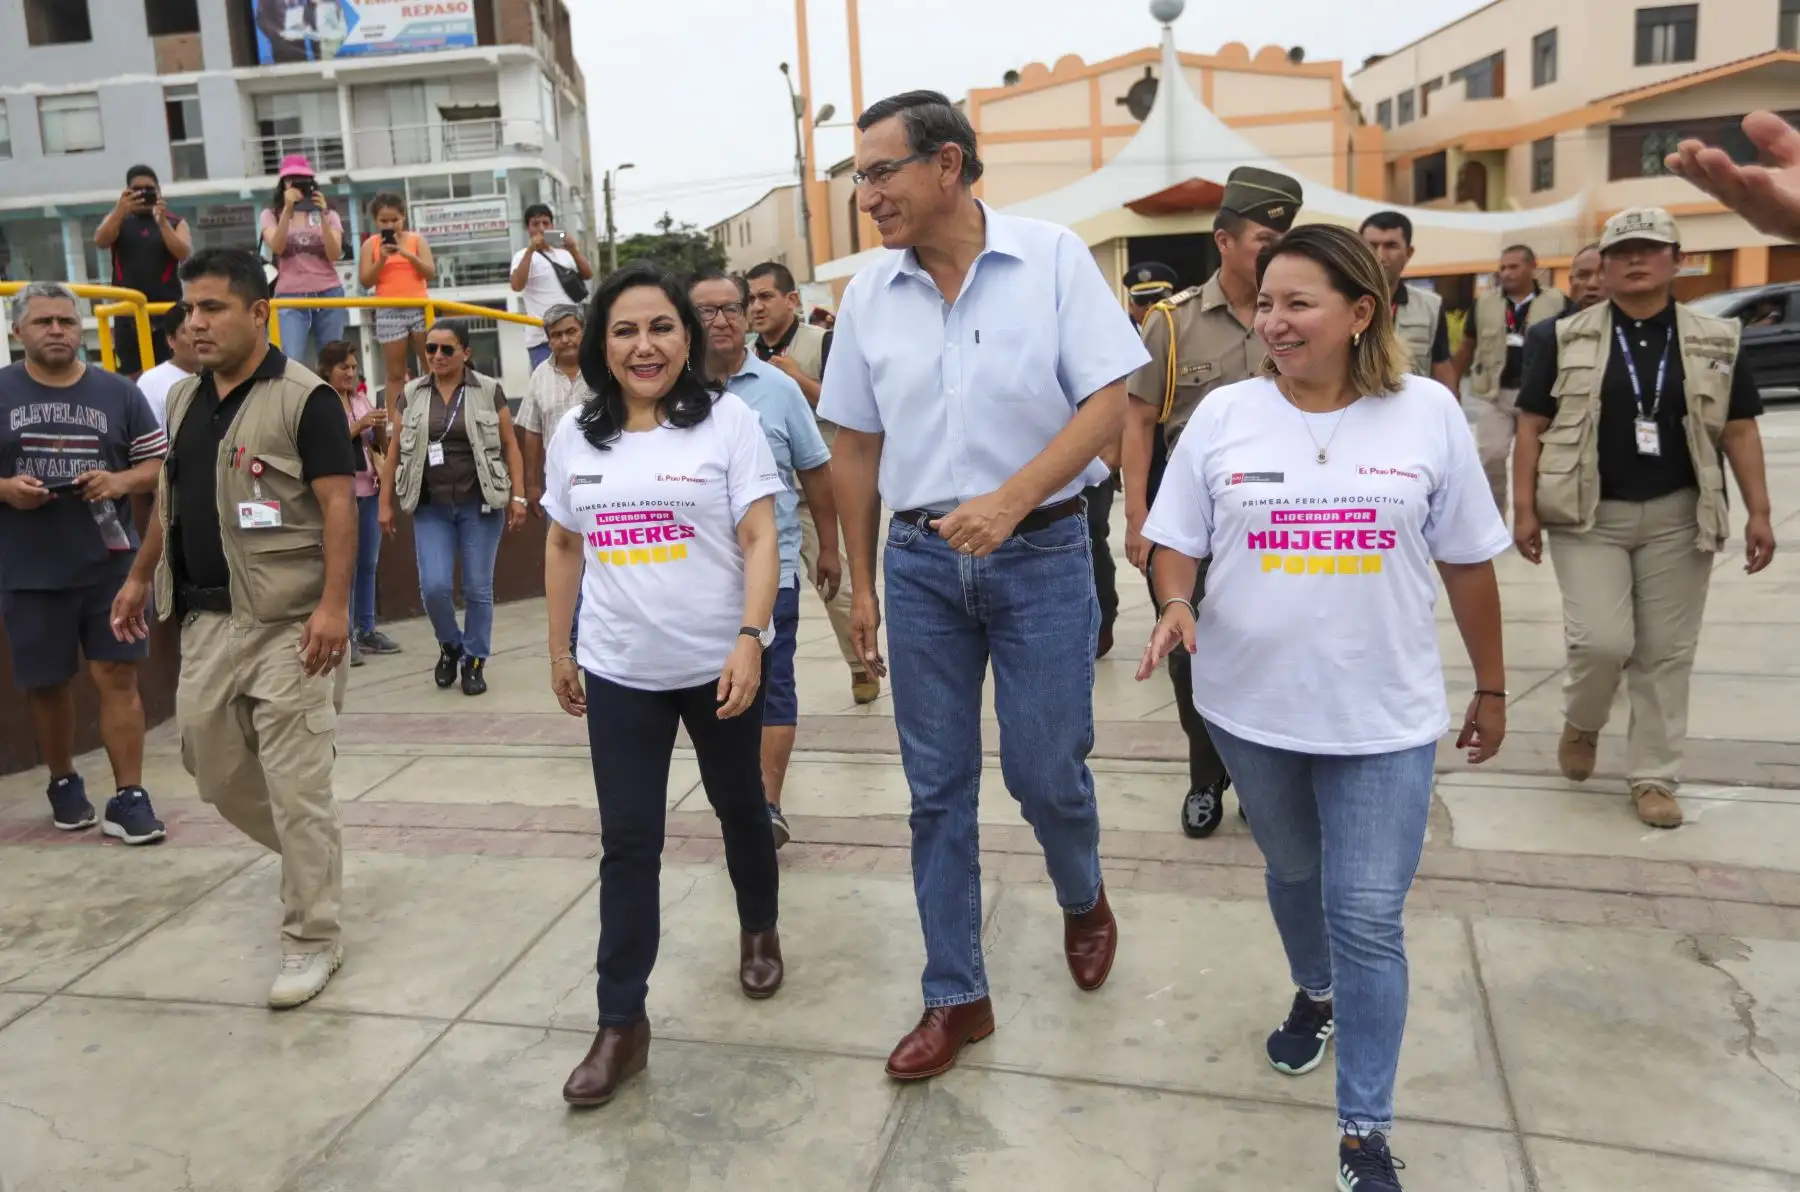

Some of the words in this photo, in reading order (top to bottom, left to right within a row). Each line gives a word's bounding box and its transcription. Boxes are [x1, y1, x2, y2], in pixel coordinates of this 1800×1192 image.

[401, 2, 469, 17] REPASO
[10, 402, 108, 434] CLEVELAND
[575, 502, 608, 512] PRIMERA
[1242, 498, 1290, 508] PRIMERA
[1295, 497, 1328, 505] FERIA
[1333, 496, 1405, 506] PRODUCTIVA
[650, 512, 671, 521] POR
[1344, 511, 1372, 521] POR
[587, 524, 696, 547] MUJERES
[1247, 530, 1396, 550] MUJERES
